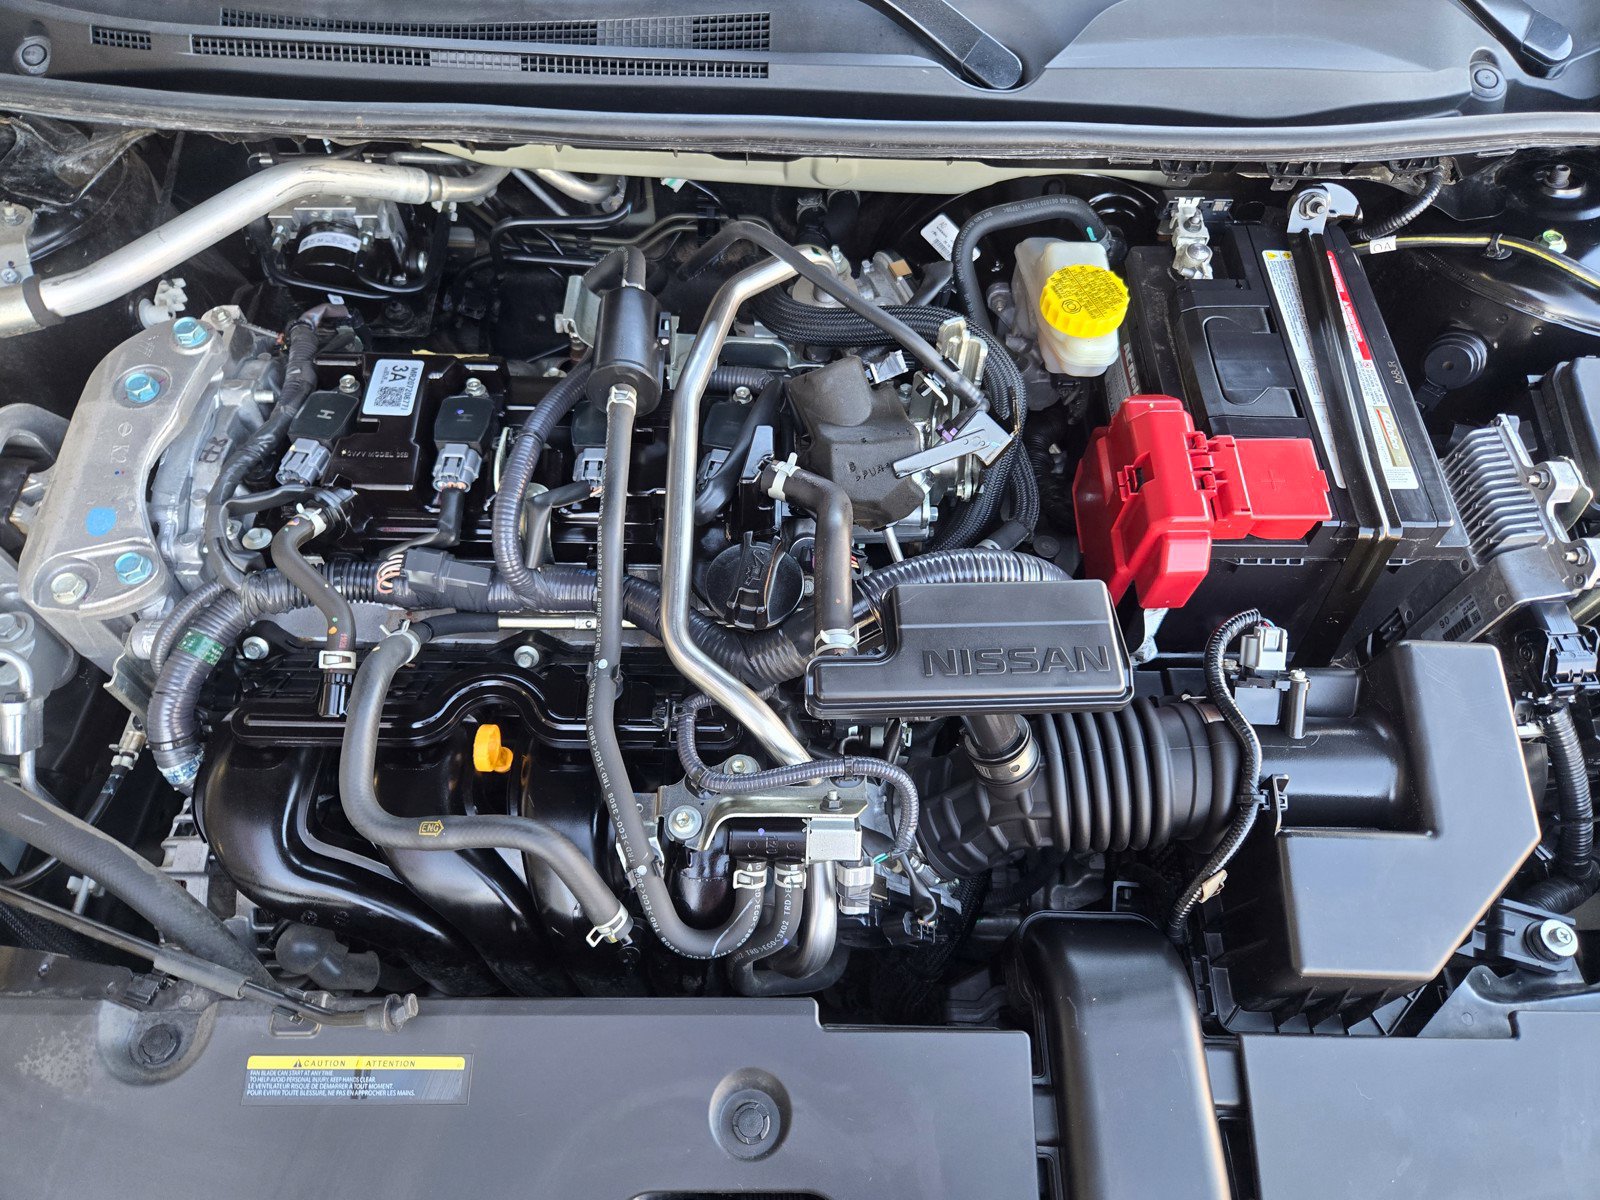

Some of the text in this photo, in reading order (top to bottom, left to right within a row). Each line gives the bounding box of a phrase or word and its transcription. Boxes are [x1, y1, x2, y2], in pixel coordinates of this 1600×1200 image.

[388, 365, 409, 382] 3A
[922, 645, 1111, 677] NISSAN
[421, 823, 440, 832] ENG
